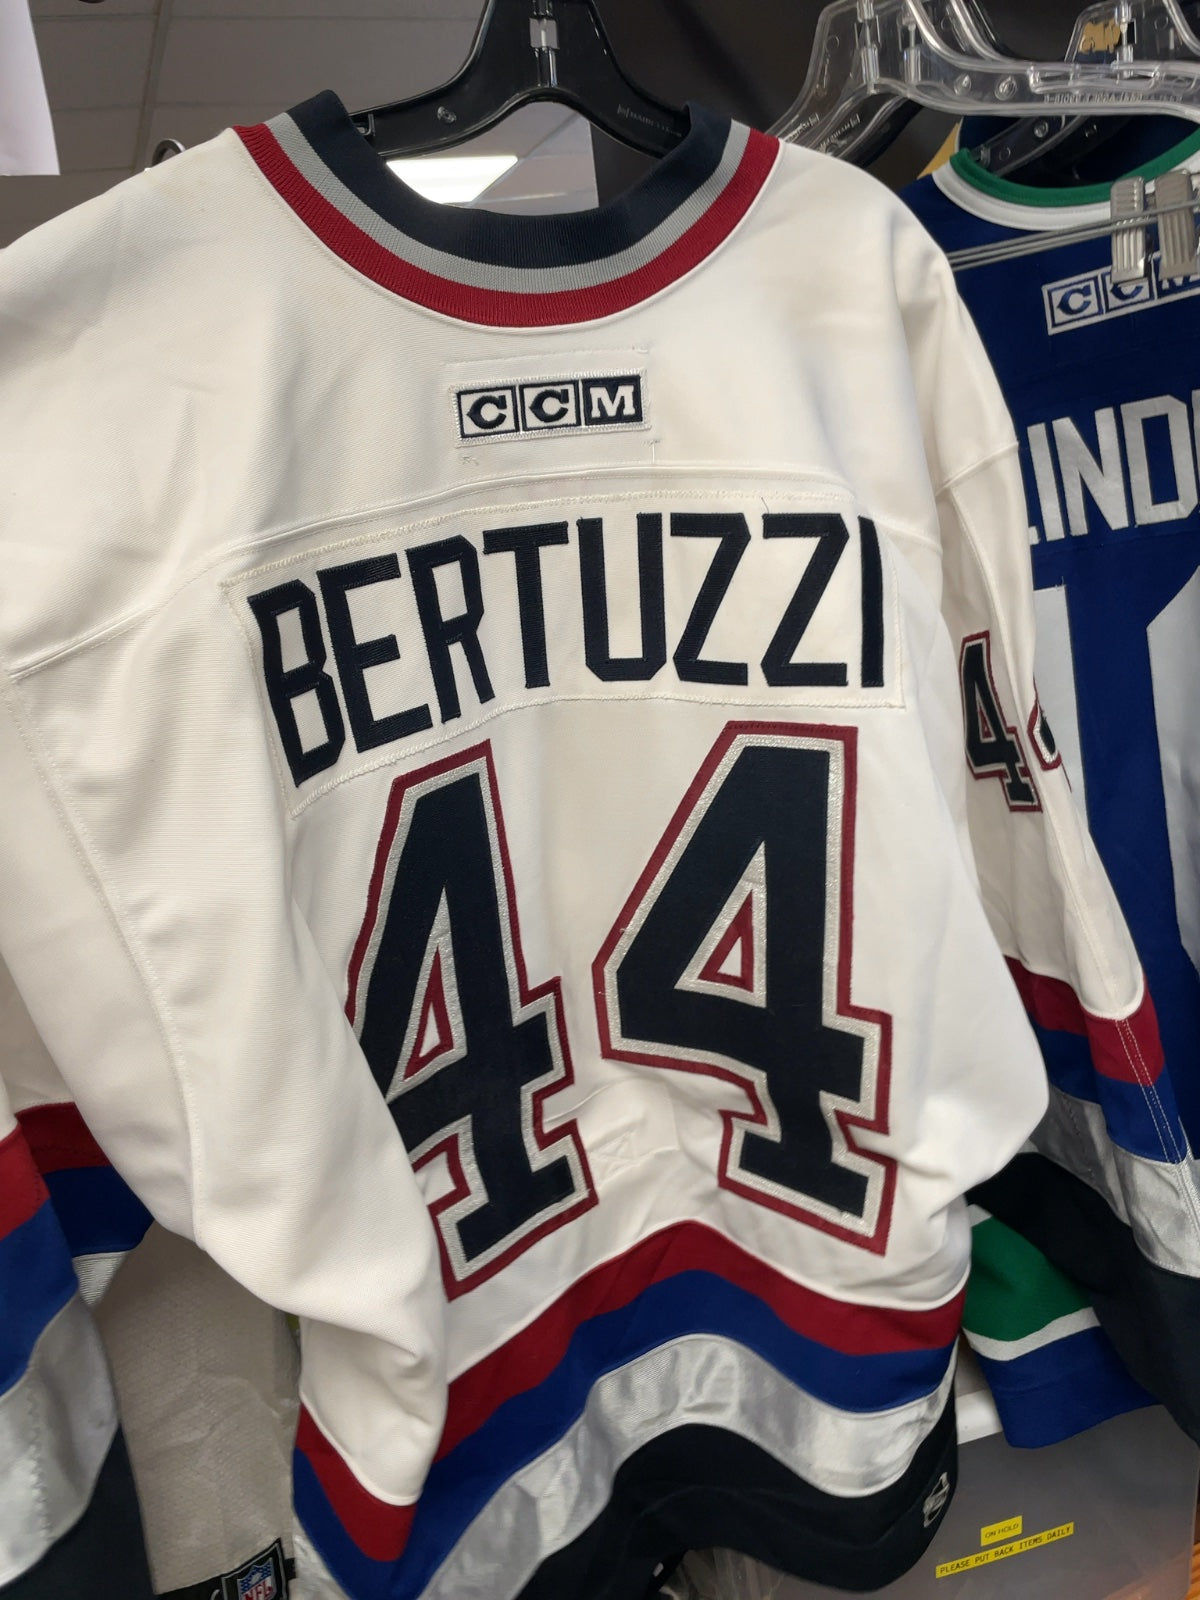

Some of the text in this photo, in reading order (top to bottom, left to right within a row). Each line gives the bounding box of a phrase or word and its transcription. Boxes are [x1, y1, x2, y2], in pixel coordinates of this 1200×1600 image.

[463, 382, 638, 431] CCM
[1028, 388, 1200, 545] IND
[247, 512, 884, 788] BERTUZZI
[344, 720, 894, 1304] 44
[940, 1526, 1072, 1574] PLEASE PUT BACK ITEMS DAILY
[984, 1523, 1019, 1539] ON HOLD
